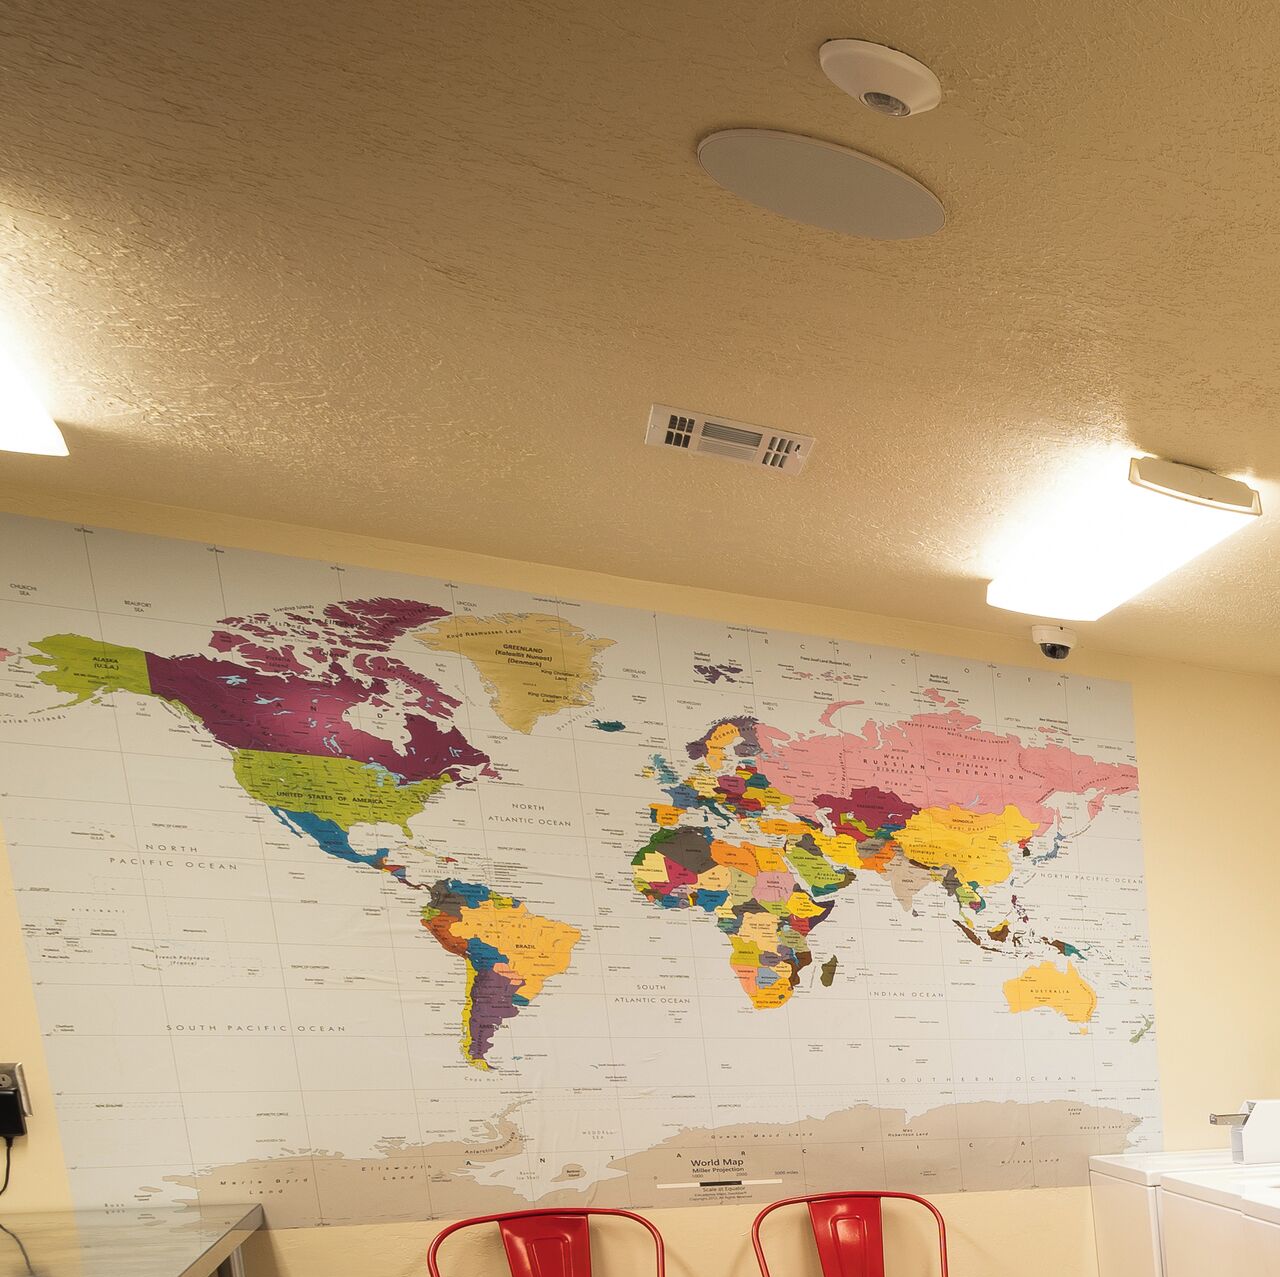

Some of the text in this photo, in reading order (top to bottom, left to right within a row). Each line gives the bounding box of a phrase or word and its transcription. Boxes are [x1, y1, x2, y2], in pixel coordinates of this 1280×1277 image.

[124, 600, 151, 608] BEAUFORT
[503, 644, 543, 653] GREENLAND
[507, 657, 542, 667] (Denmark)
[936, 750, 1008, 763] Central Siberian
[863, 758, 925, 771] RUSSIAN
[937, 766, 1024, 781] FEDERATION
[876, 766, 914, 774] Siberian
[956, 761, 989, 770] Plateau
[512, 803, 545, 811] NORTH
[489, 816, 534, 824] ATLANTIC
[146, 844, 198, 853] NORTH
[109, 857, 237, 870] PACIFIC OCEAN
[166, 1024, 217, 1032] SOUTH
[691, 1159, 744, 1167] World Map
